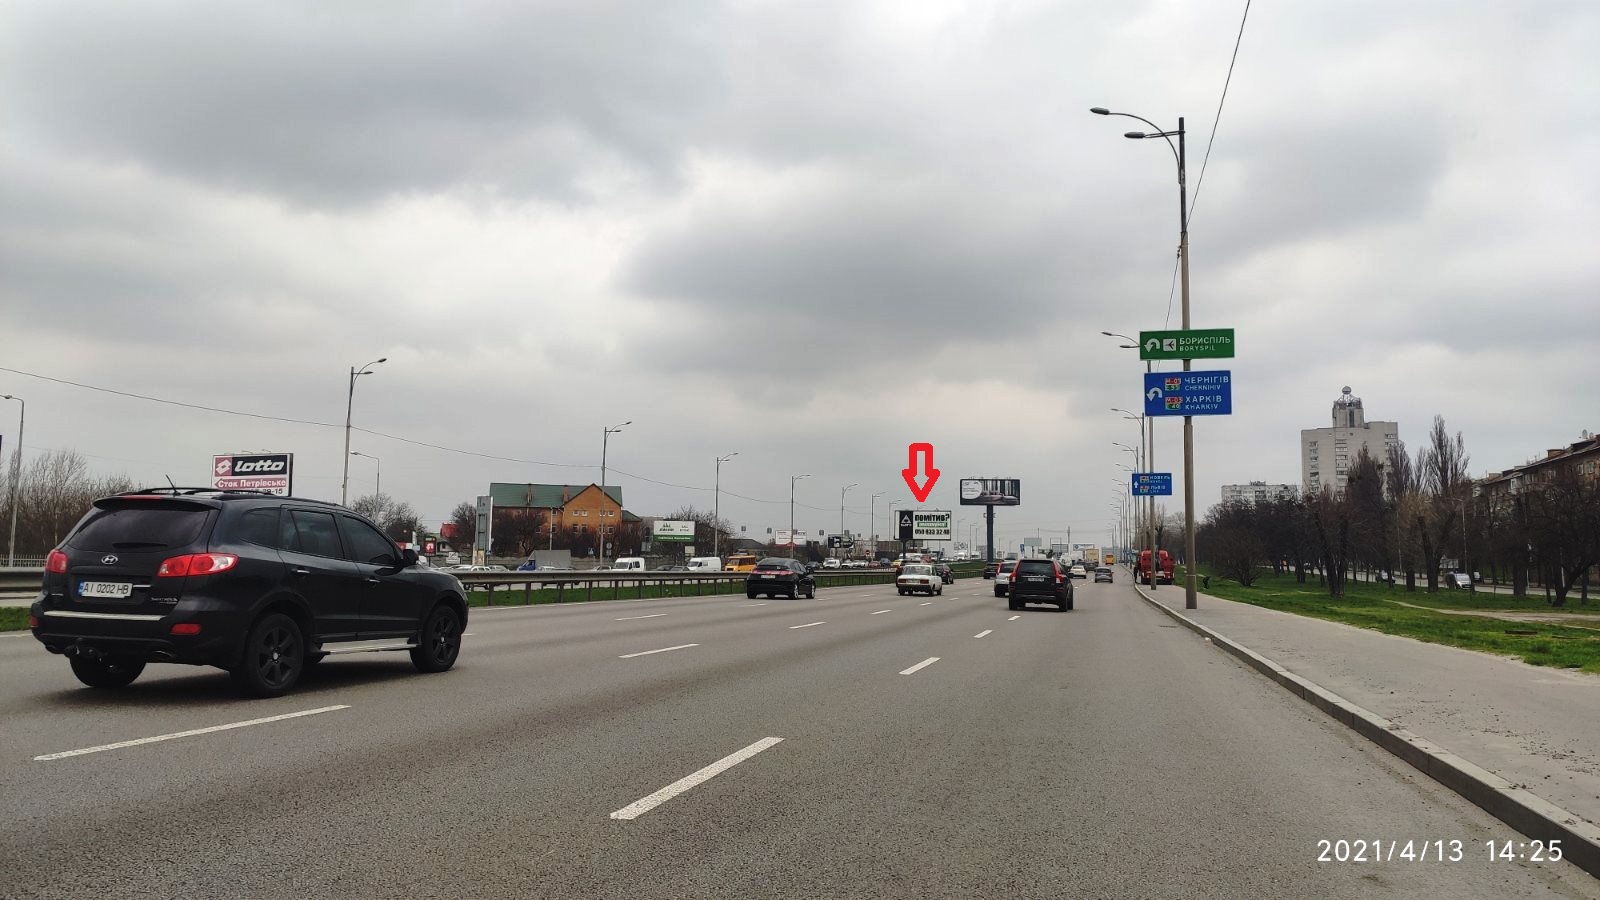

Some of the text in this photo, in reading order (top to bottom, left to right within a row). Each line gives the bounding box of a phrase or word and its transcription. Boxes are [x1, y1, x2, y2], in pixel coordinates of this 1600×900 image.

[1179, 336, 1231, 345] БОРИСПІЛЬ
[1184, 376, 1229, 384] ЧЕРНІГІВ
[1185, 395, 1223, 403] ХАРКІВ
[234, 459, 285, 472] lotto
[218, 478, 286, 489] Сток Петрівське
[96, 583, 116, 594] 0202
